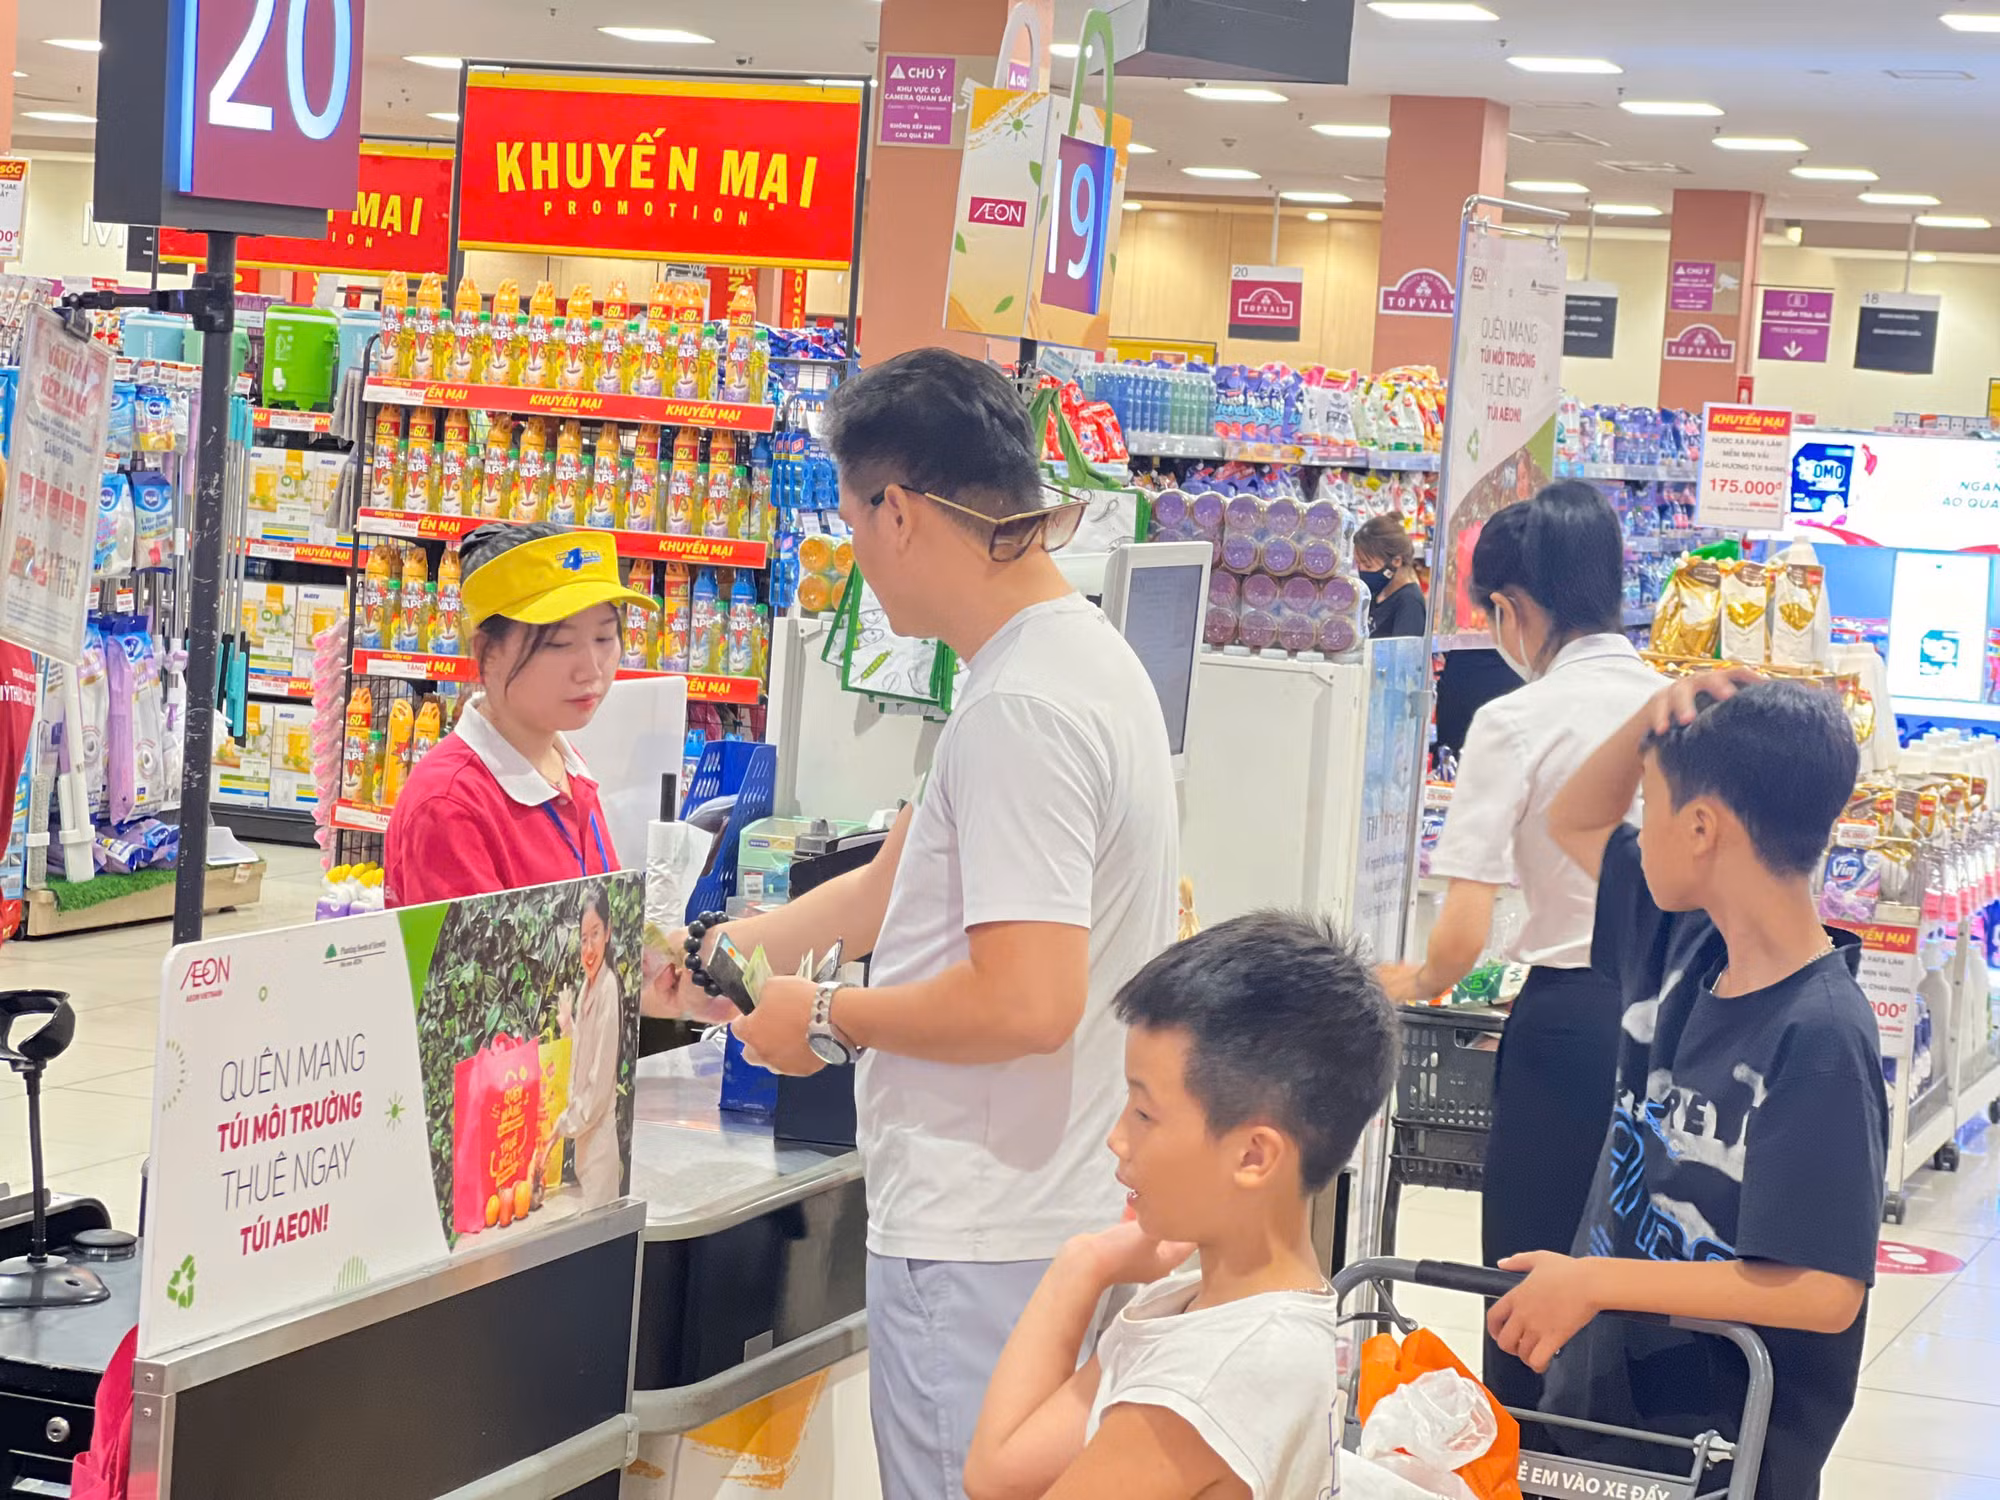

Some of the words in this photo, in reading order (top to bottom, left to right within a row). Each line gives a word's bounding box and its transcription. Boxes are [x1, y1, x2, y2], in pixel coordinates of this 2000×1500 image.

[209, 0, 352, 140] 20
[908, 65, 935, 79] CHÚ
[937, 66, 947, 80] Ý
[496, 128, 698, 193] KHUYẾN
[720, 150, 818, 211] MẠI
[352, 193, 424, 238] MẠI
[544, 200, 749, 227] PROMOTION
[1048, 158, 1097, 280] 19
[1233, 266, 1249, 278] 20
[1243, 303, 1289, 314] TOPVALU
[1864, 293, 1879, 304] 18
[1482, 315, 1506, 341] QUÊN
[1508, 320, 1538, 345] MANG
[1480, 345, 1491, 364] TÚI
[1671, 345, 1729, 357] TOPVALU
[425, 383, 443, 398] ẾN
[445, 388, 468, 402] MẠI
[1481, 372, 1505, 396] THUÊ
[529, 393, 579, 409] KHUYẾN
[580, 397, 603, 412] MẠI
[665, 402, 716, 419] KHUYẾN
[718, 407, 742, 423] MẠI
[1712, 412, 1762, 427] KHUYẾN
[1763, 415, 1785, 430] MẠI
[1814, 463, 1844, 480] OMO
[418, 515, 437, 530] ẾN
[438, 520, 460, 535] MẠI
[295, 545, 332, 559] KHUYẾN
[332, 550, 350, 562] MẠI
[659, 539, 709, 555] KHUYẾN
[711, 543, 734, 560] MẠI
[433, 661, 456, 676] MẠI
[708, 682, 731, 697] MẠI
[1831, 861, 1861, 881] Vim
[1886, 931, 1910, 947] MẠI
[219, 1047, 291, 1103] QUÊN
[297, 1032, 366, 1086] MANG
[217, 1111, 249, 1153] TÚI
[252, 1103, 287, 1145] MÔI
[290, 1089, 363, 1135] TRƯỜNG
[221, 1151, 288, 1211] THUÊ
[293, 1138, 355, 1192] NGAY
[240, 1215, 271, 1256] TÚI
[272, 1203, 329, 1247] AEON!
[1530, 1466, 1559, 1488] EM
[1562, 1467, 1601, 1494] VÀO
[1602, 1480, 1628, 1500] XE
[1630, 1484, 1670, 1500] ĐẨY
